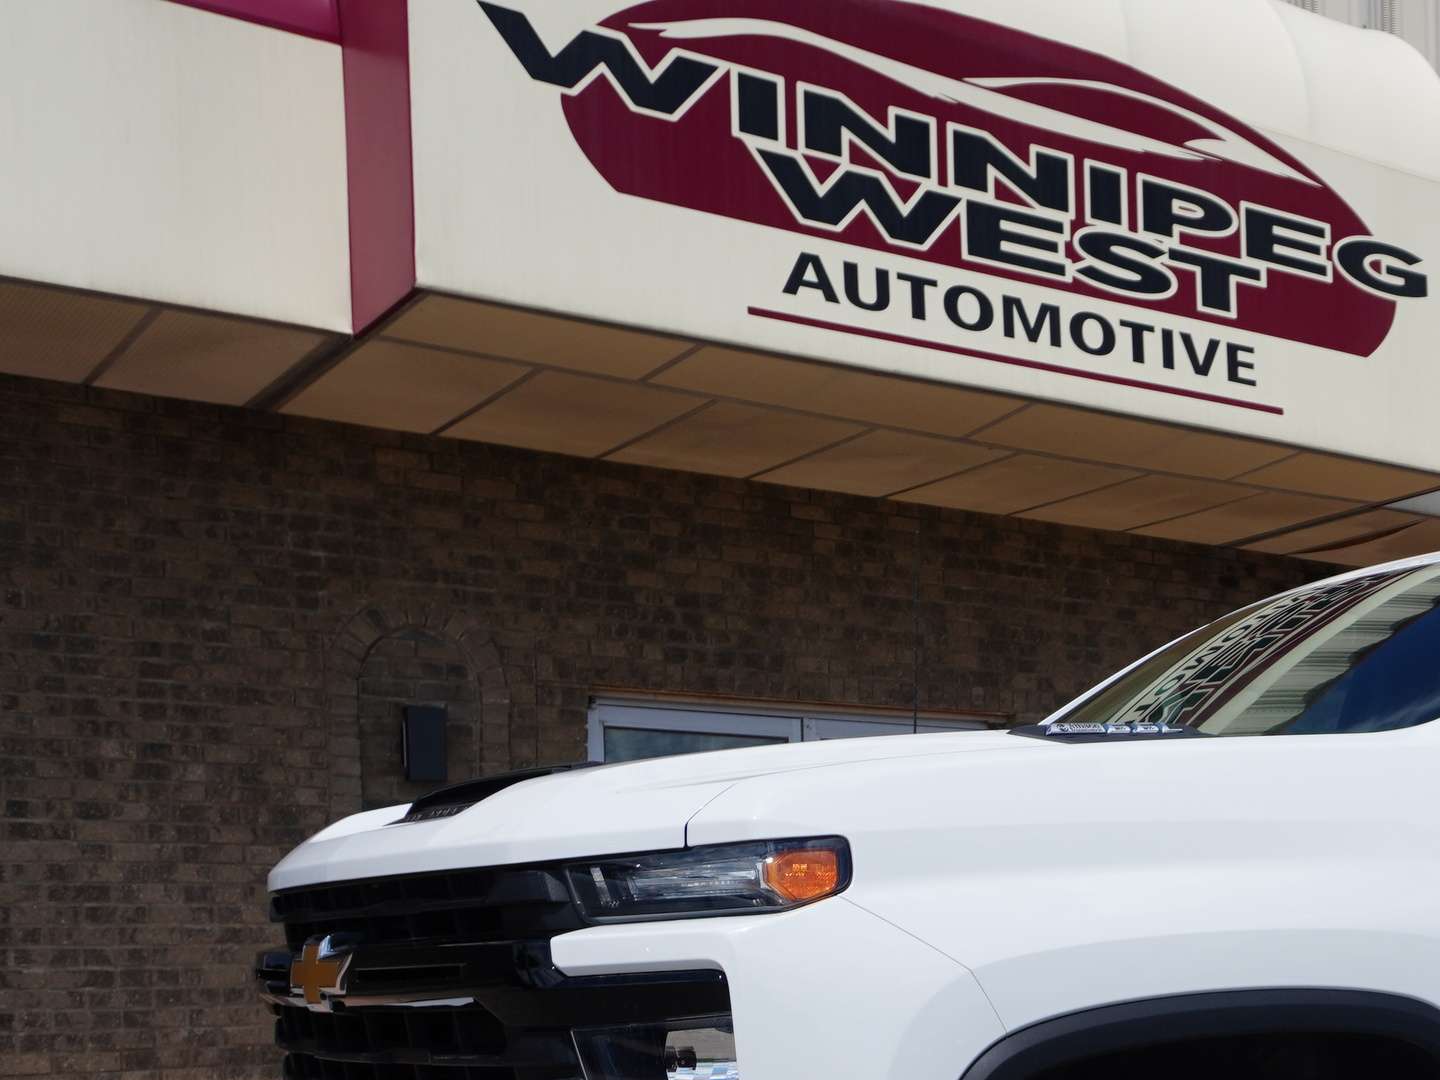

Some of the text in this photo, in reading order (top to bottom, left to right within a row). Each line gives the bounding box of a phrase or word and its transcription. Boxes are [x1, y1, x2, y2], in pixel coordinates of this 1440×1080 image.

[476, 0, 1428, 298] WINNIPEG
[757, 148, 1263, 318] WEST
[782, 251, 1258, 387] AUTOMOTIVE
